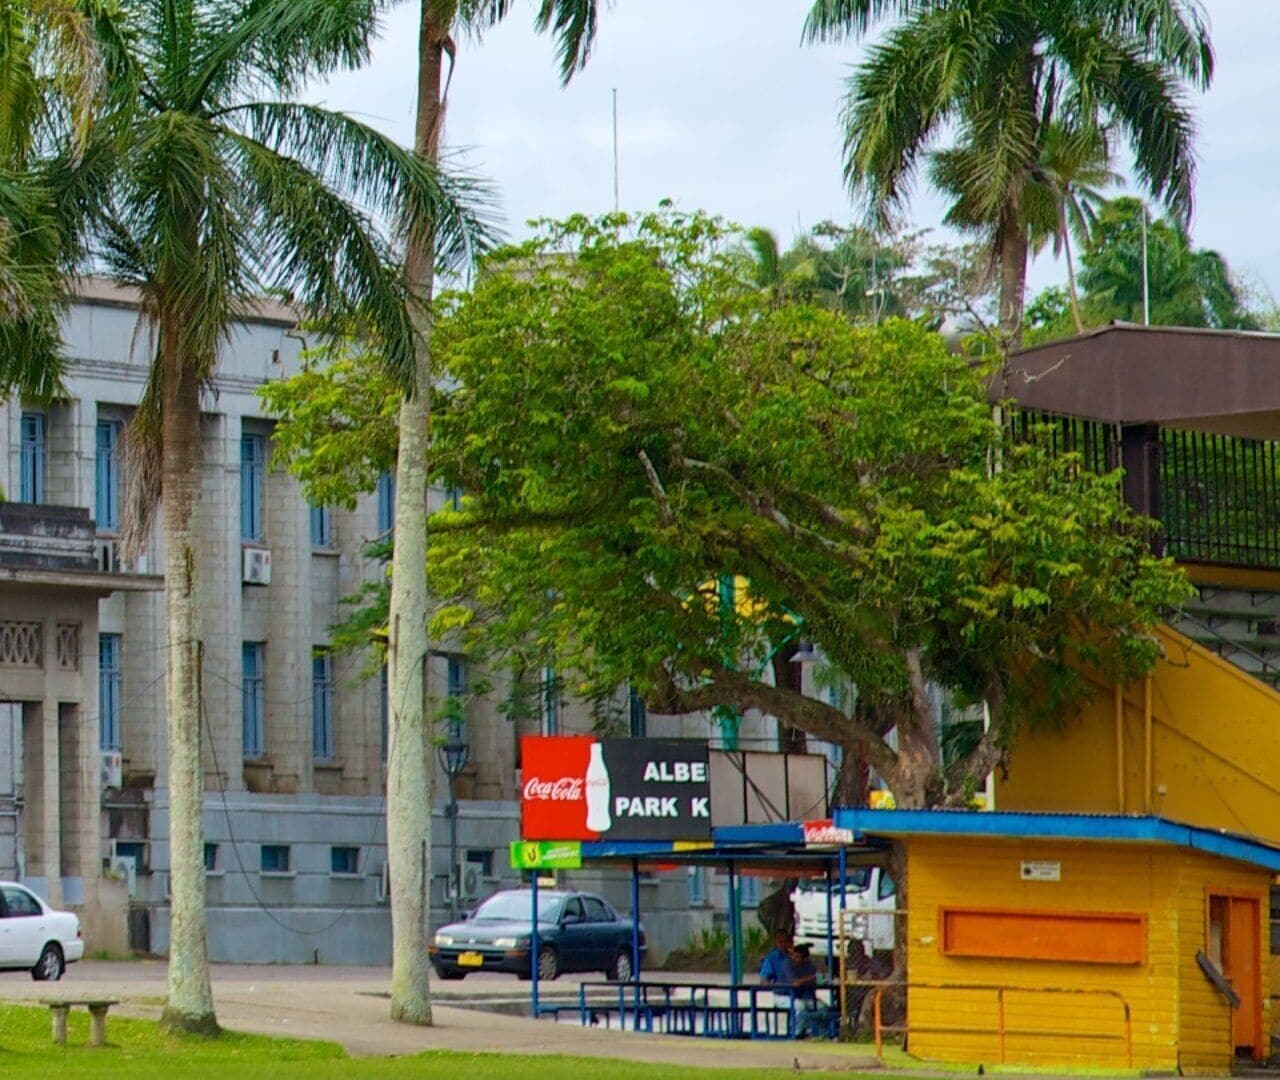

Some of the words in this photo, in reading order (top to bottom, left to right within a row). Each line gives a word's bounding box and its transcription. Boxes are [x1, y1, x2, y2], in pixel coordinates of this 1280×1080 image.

[643, 762, 709, 782] ALBE
[524, 777, 583, 800] Coca-Cola
[615, 796, 678, 817] PARK
